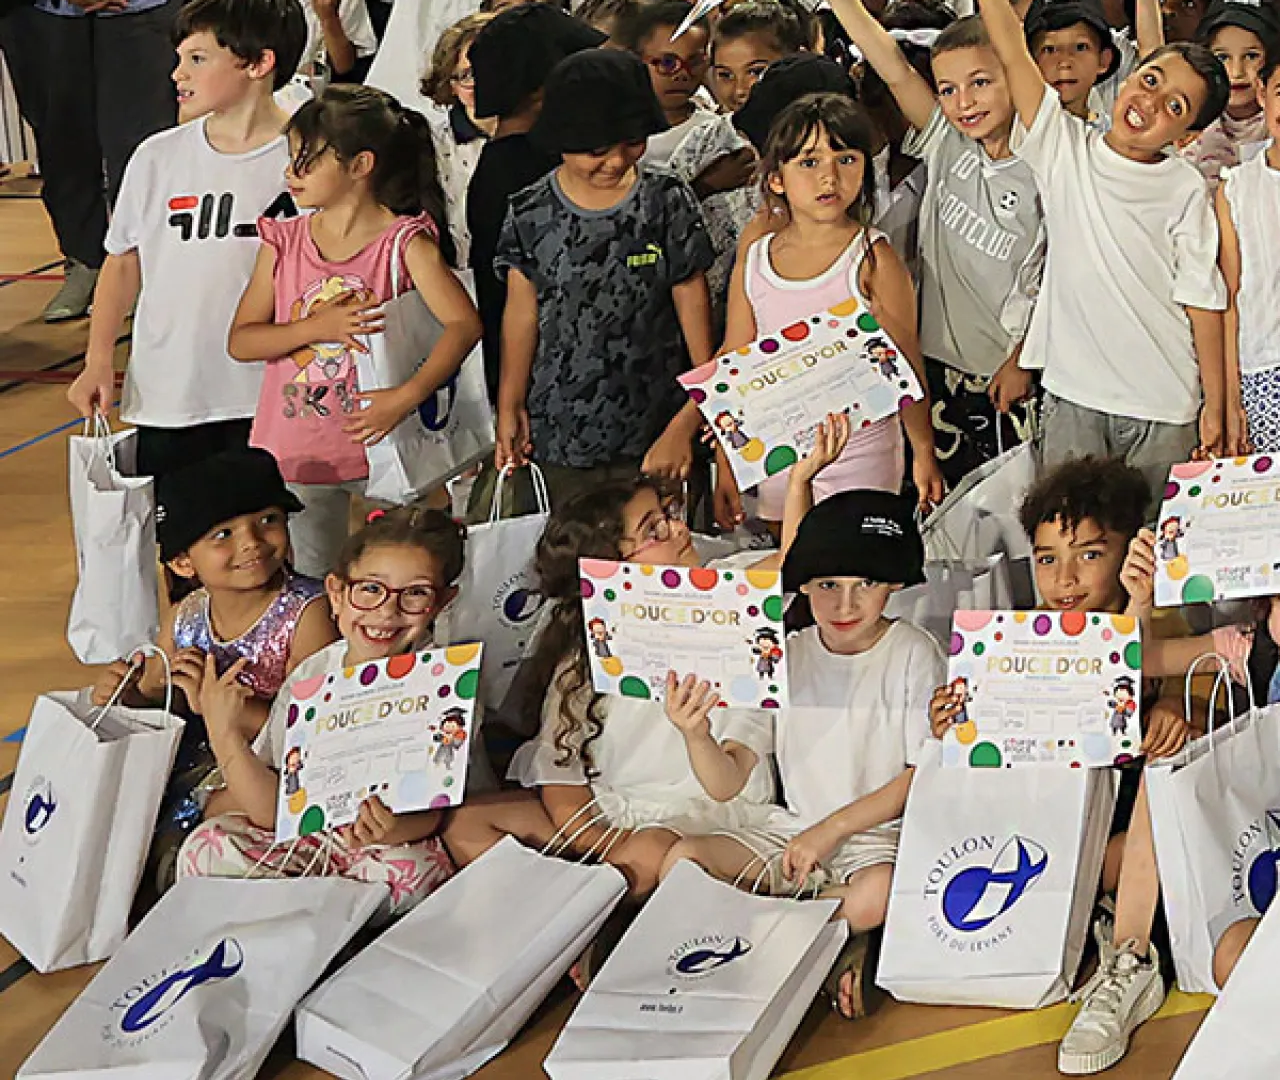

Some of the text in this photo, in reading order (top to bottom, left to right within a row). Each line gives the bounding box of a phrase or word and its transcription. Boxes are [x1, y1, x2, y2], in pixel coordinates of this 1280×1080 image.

[802, 340, 848, 368] D'OR
[1201, 489, 1269, 509] POUCE
[621, 603, 740, 626] POUCE D'OR
[987, 657, 1103, 675] POUCE D'OR
[378, 694, 429, 719] D'OR
[924, 835, 995, 900] TOULON
